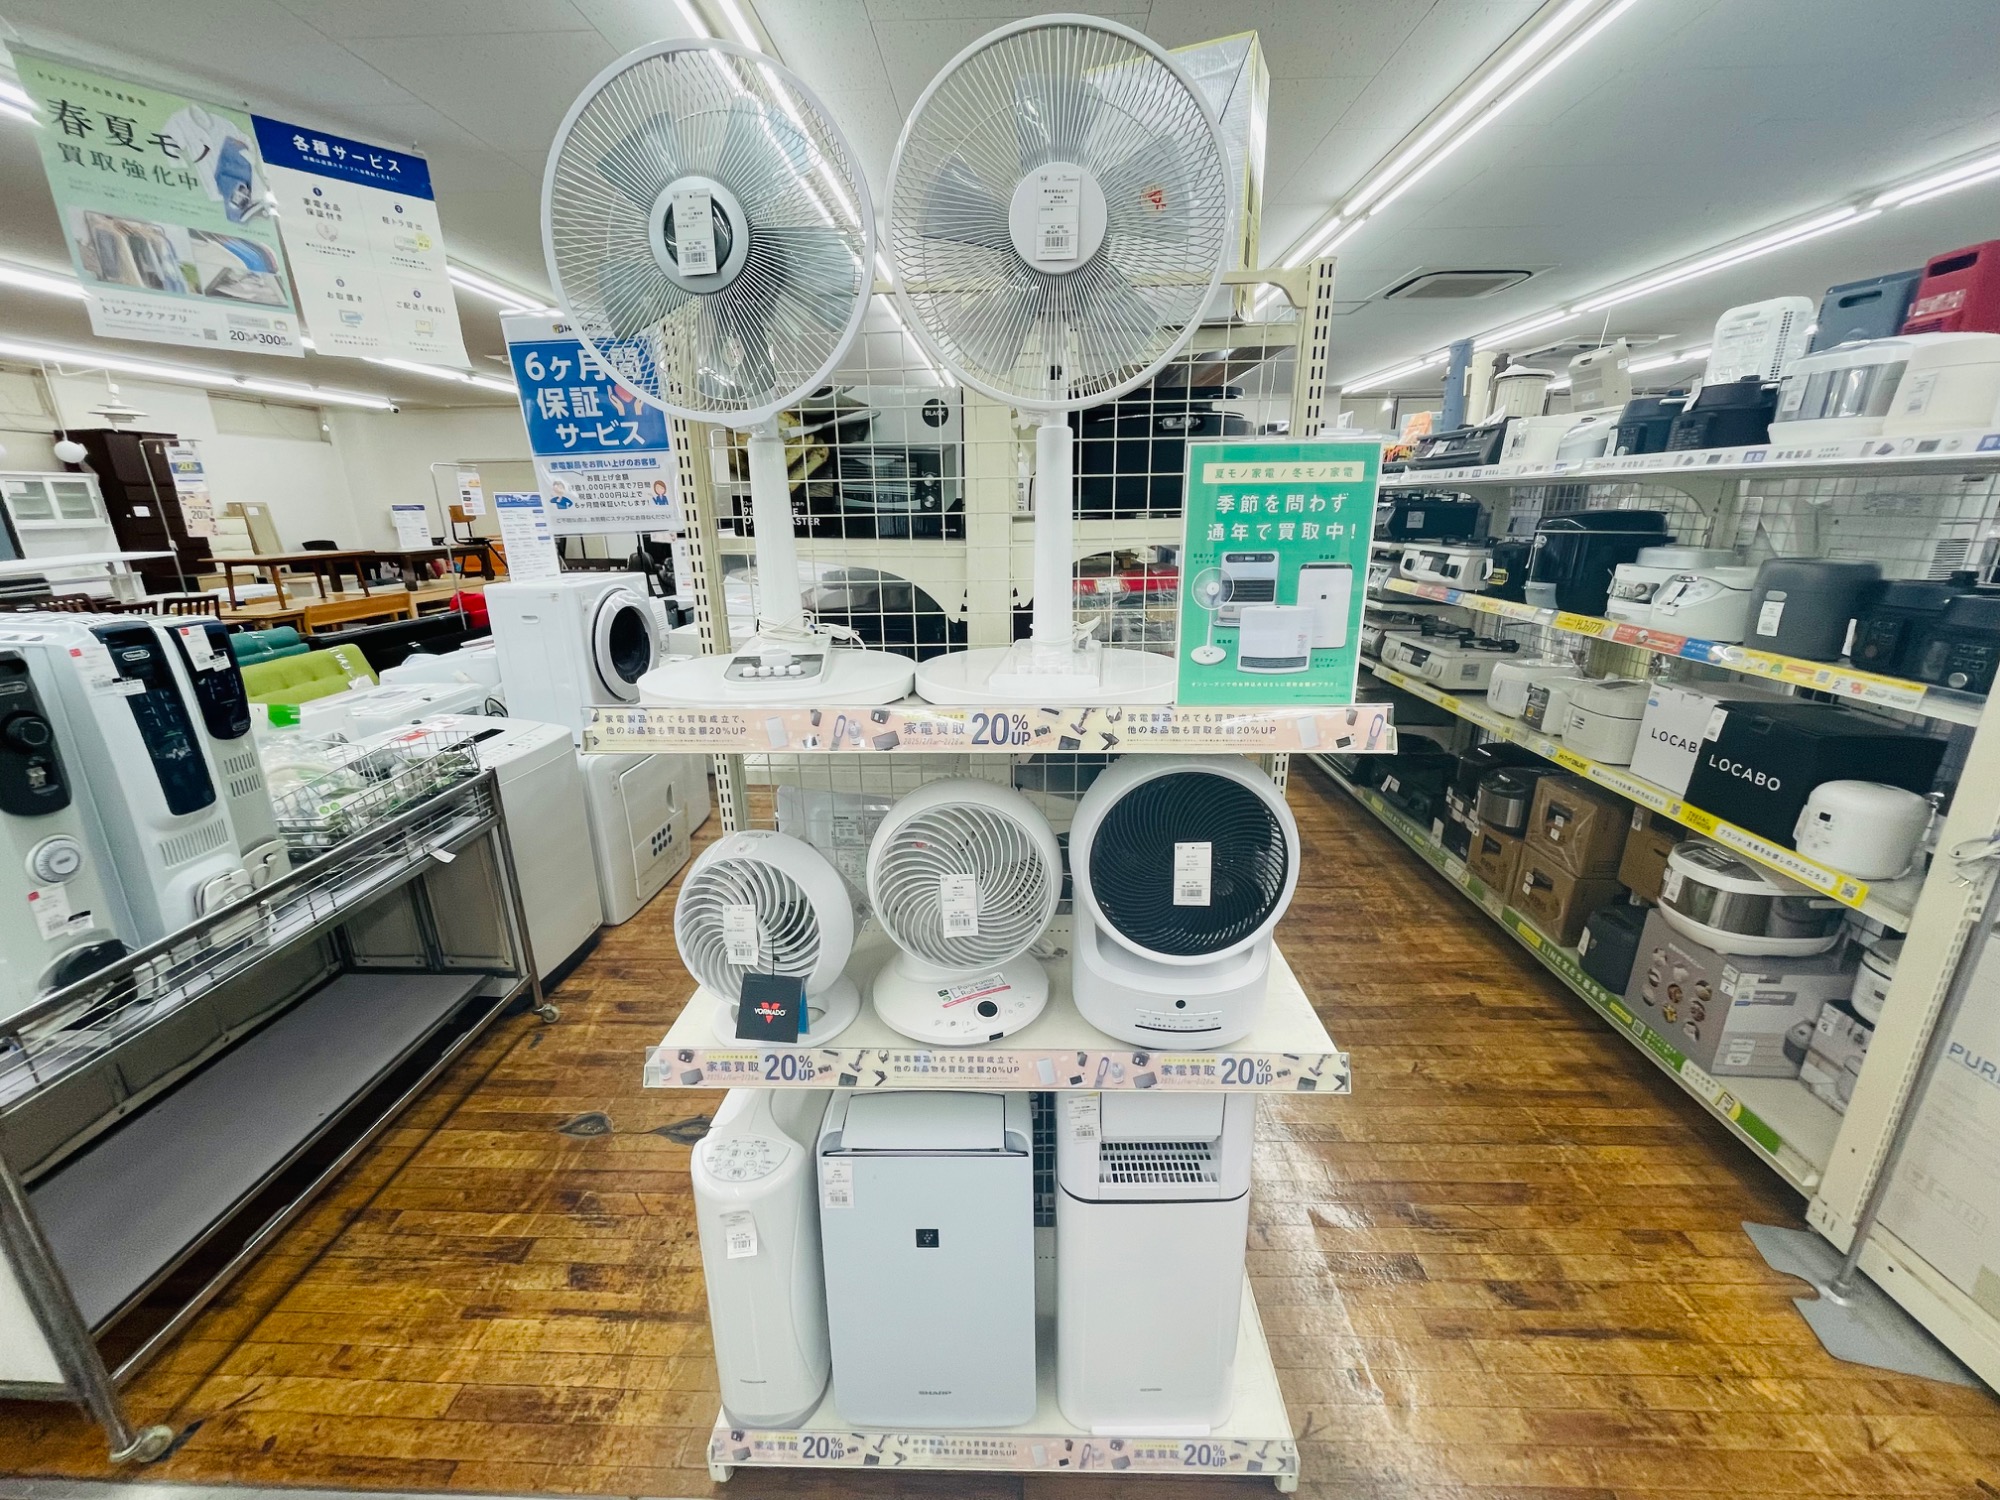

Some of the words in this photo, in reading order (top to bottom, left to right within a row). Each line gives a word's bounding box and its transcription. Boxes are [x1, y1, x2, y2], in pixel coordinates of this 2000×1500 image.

[47, 99, 210, 163] 春夏モノ
[292, 134, 401, 173] 各種サービス
[57, 142, 199, 190] 買取強化中
[536, 386, 603, 420] 保証
[555, 419, 646, 449] サービス
[1216, 492, 1349, 514] 季節を問わず
[1206, 523, 1356, 541] 通年で買取中!
[606, 726, 747, 735] 他のお品物も買取金額20%UP
[903, 721, 965, 736] 家電買取
[1127, 725, 1277, 735] 他のお品物も買取金額20%UP
[1651, 727, 1700, 753] LOCAB
[1708, 754, 1780, 791] LOCABO
[754, 1007, 787, 1017] VORNADO
[706, 1061, 759, 1073] 家電買取
[1160, 1064, 1216, 1076] 家電買取
[1949, 1042, 2000, 1083] PUR
[754, 1440, 798, 1451] 家電買取
[1133, 1449, 1179, 1459] 家電買取
